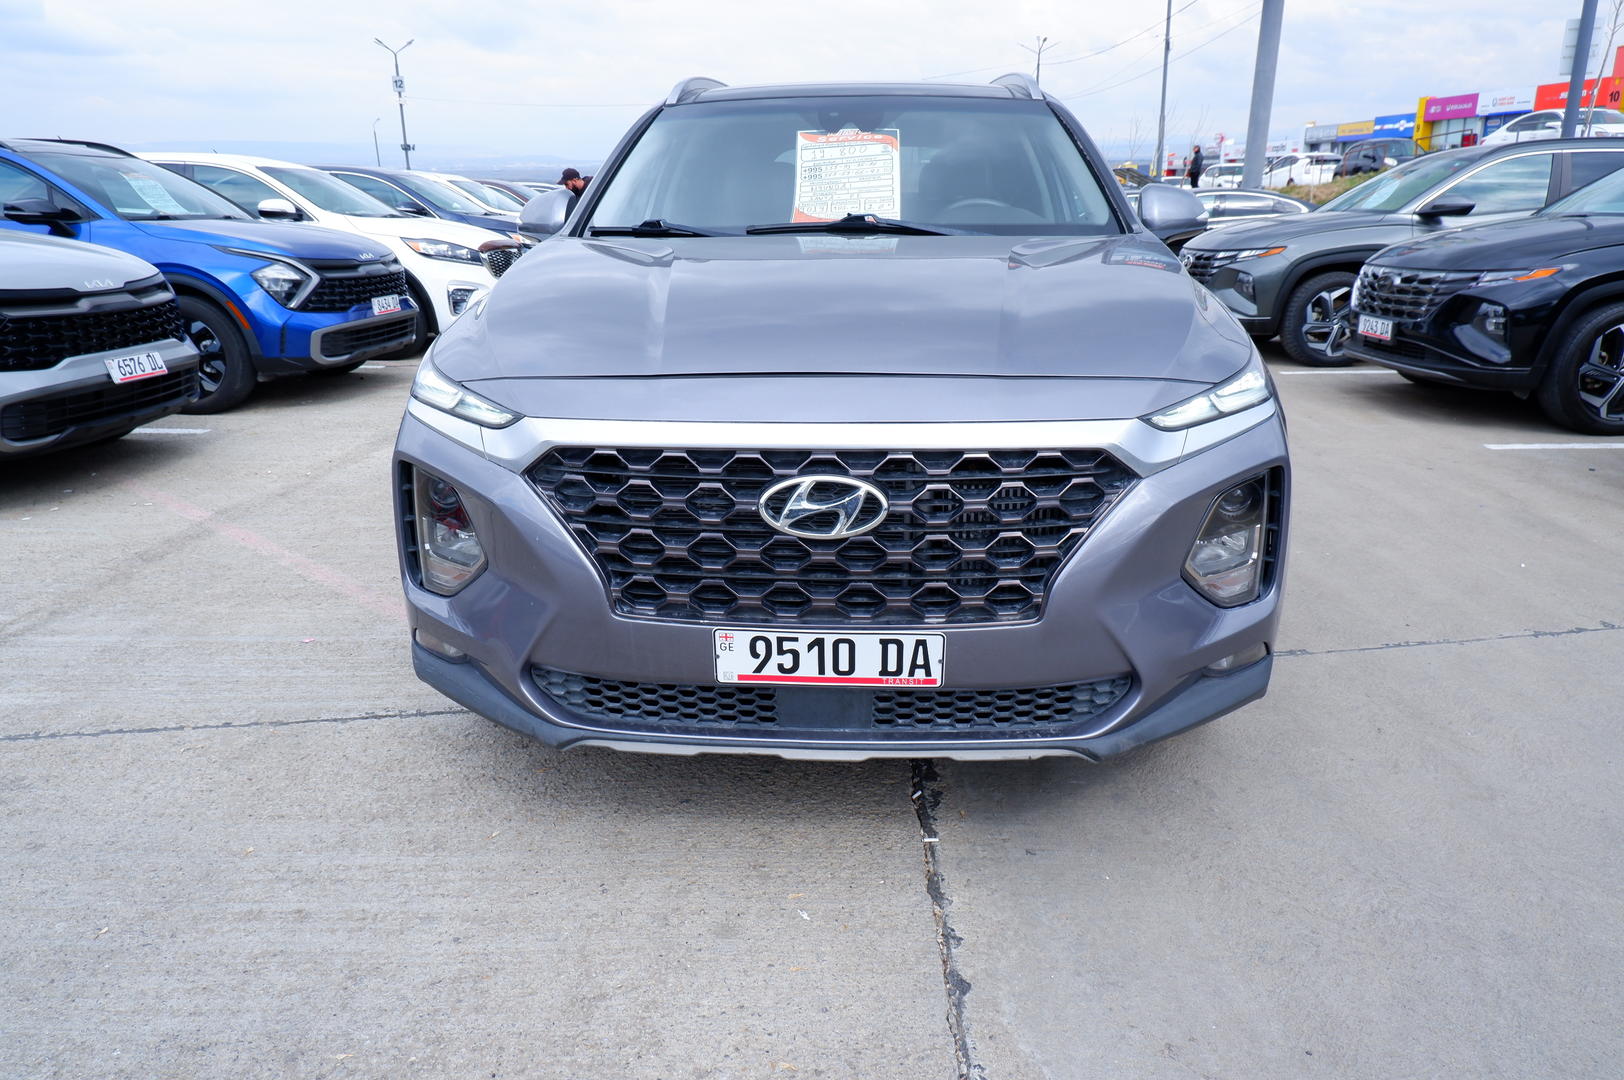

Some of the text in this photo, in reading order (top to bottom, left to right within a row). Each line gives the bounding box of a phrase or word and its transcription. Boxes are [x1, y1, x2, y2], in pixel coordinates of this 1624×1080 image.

[393, 80, 403, 88] 12
[1609, 91, 1620, 102] 10
[118, 353, 163, 377] 6576 DL
[719, 642, 735, 652] GE
[749, 635, 933, 678] 9510 DA
[882, 678, 924, 686] TRANSIT
